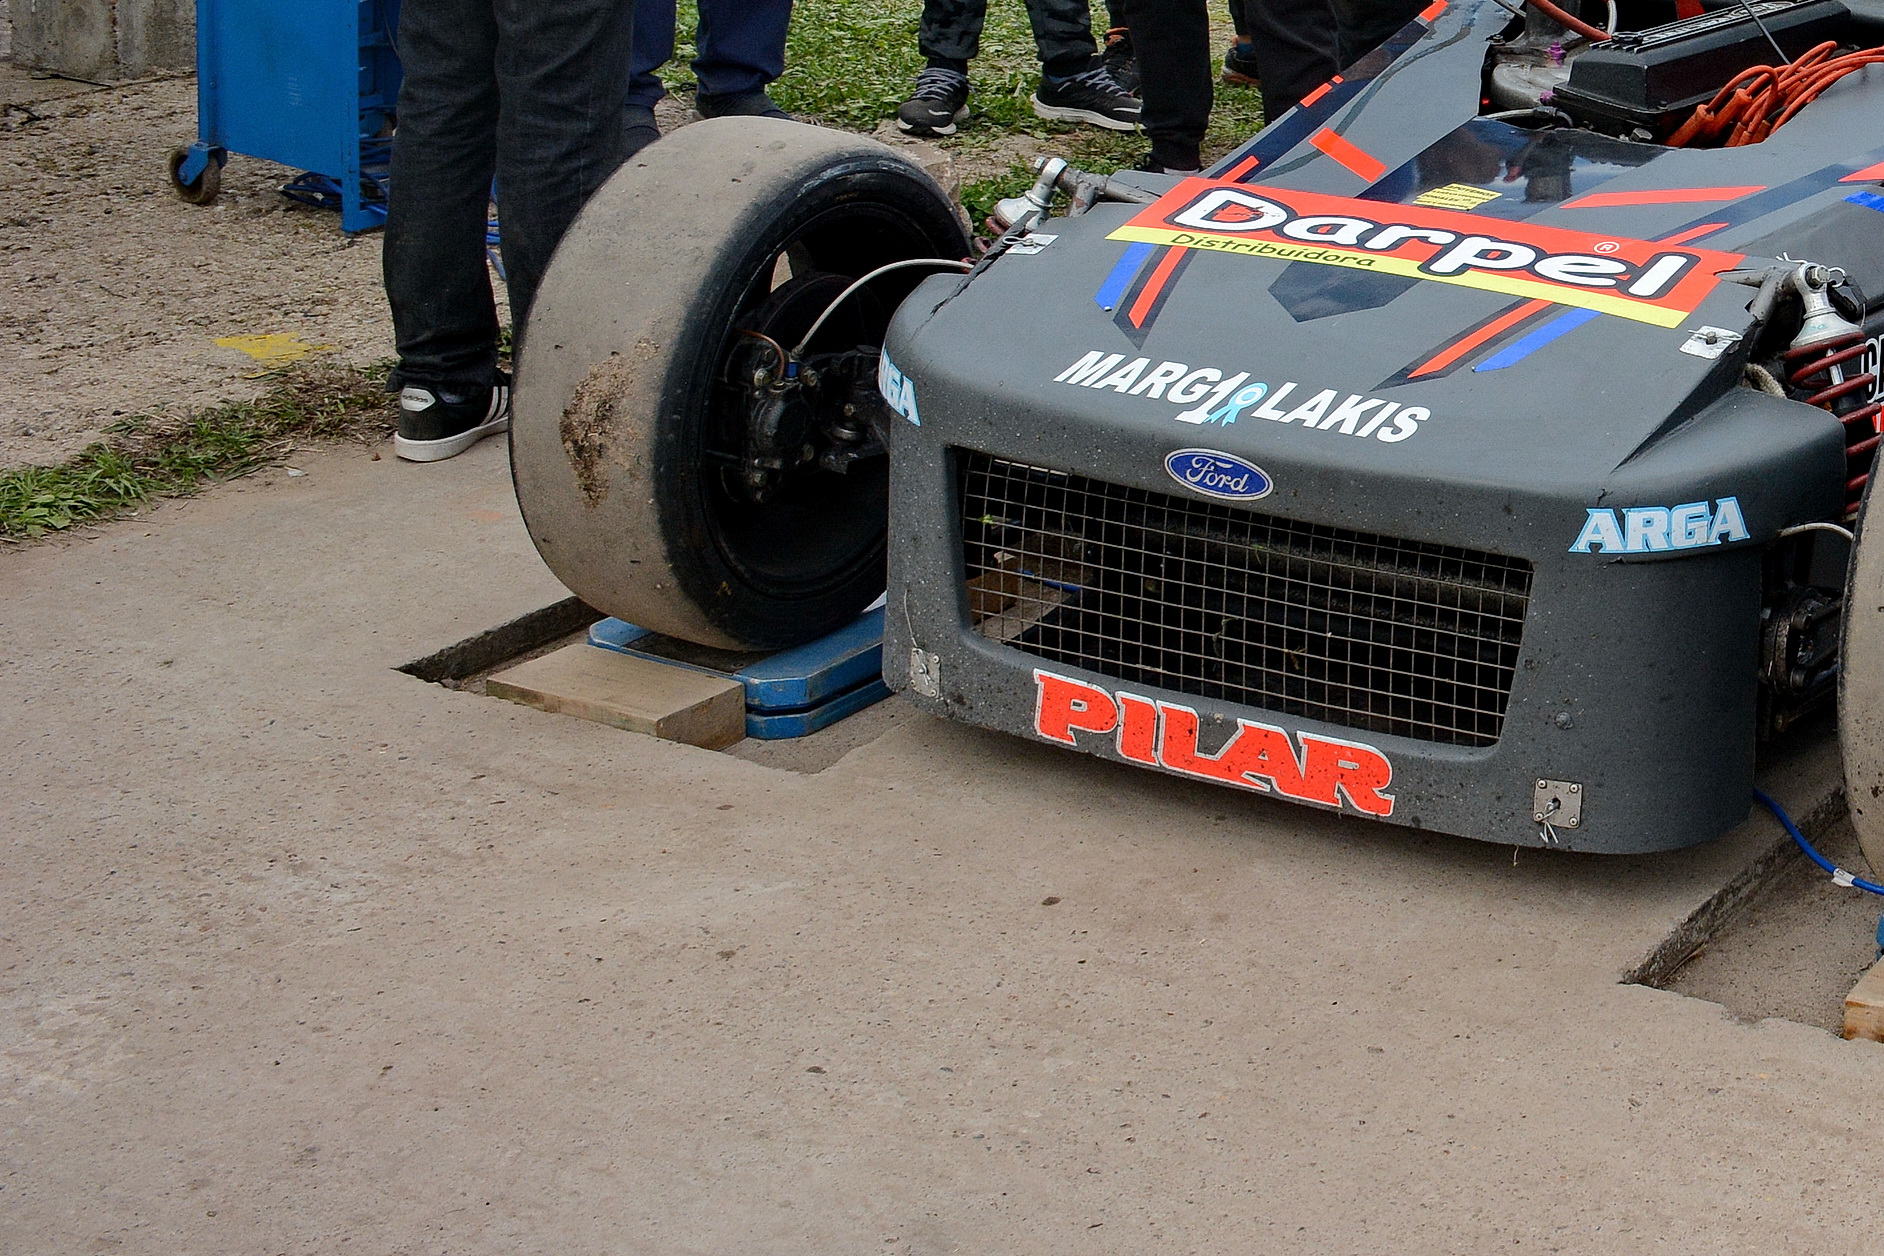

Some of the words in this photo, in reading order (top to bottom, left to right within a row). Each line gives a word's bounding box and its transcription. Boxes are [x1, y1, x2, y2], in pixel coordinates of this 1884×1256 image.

[1168, 186, 1697, 300] Darpel
[1171, 232, 1376, 268] Distribuidora
[879, 344, 921, 427] RGA
[1184, 452, 1251, 494] Ford
[1567, 496, 1751, 554] ARGA
[1033, 668, 1395, 817] PILAR
